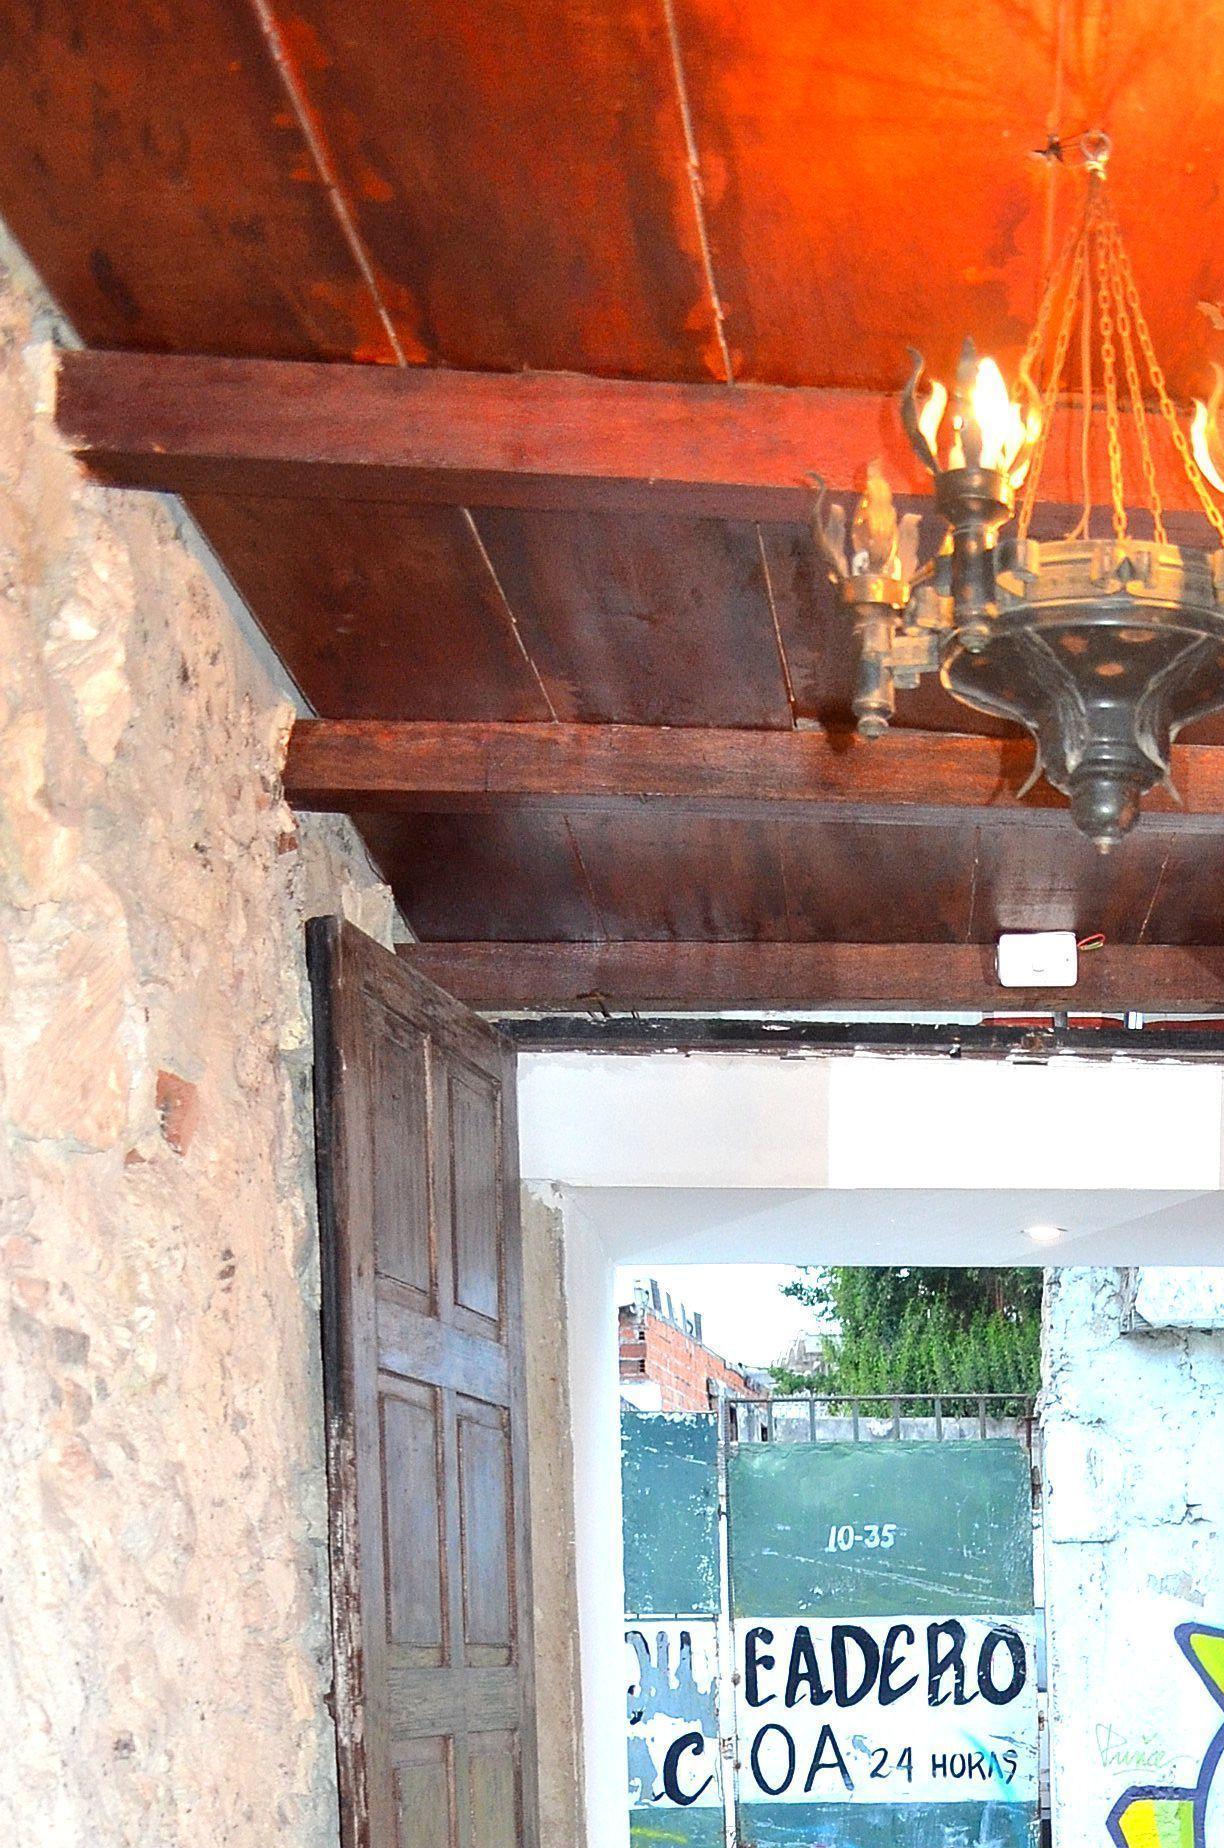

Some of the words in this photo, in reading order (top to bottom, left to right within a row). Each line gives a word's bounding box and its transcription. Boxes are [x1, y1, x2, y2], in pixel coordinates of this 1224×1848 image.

[826, 1522, 897, 1553] 10-35
[625, 1619, 1026, 1708] EADERO
[870, 1747, 913, 1783] 24
[931, 1750, 1018, 1784] HORAS
